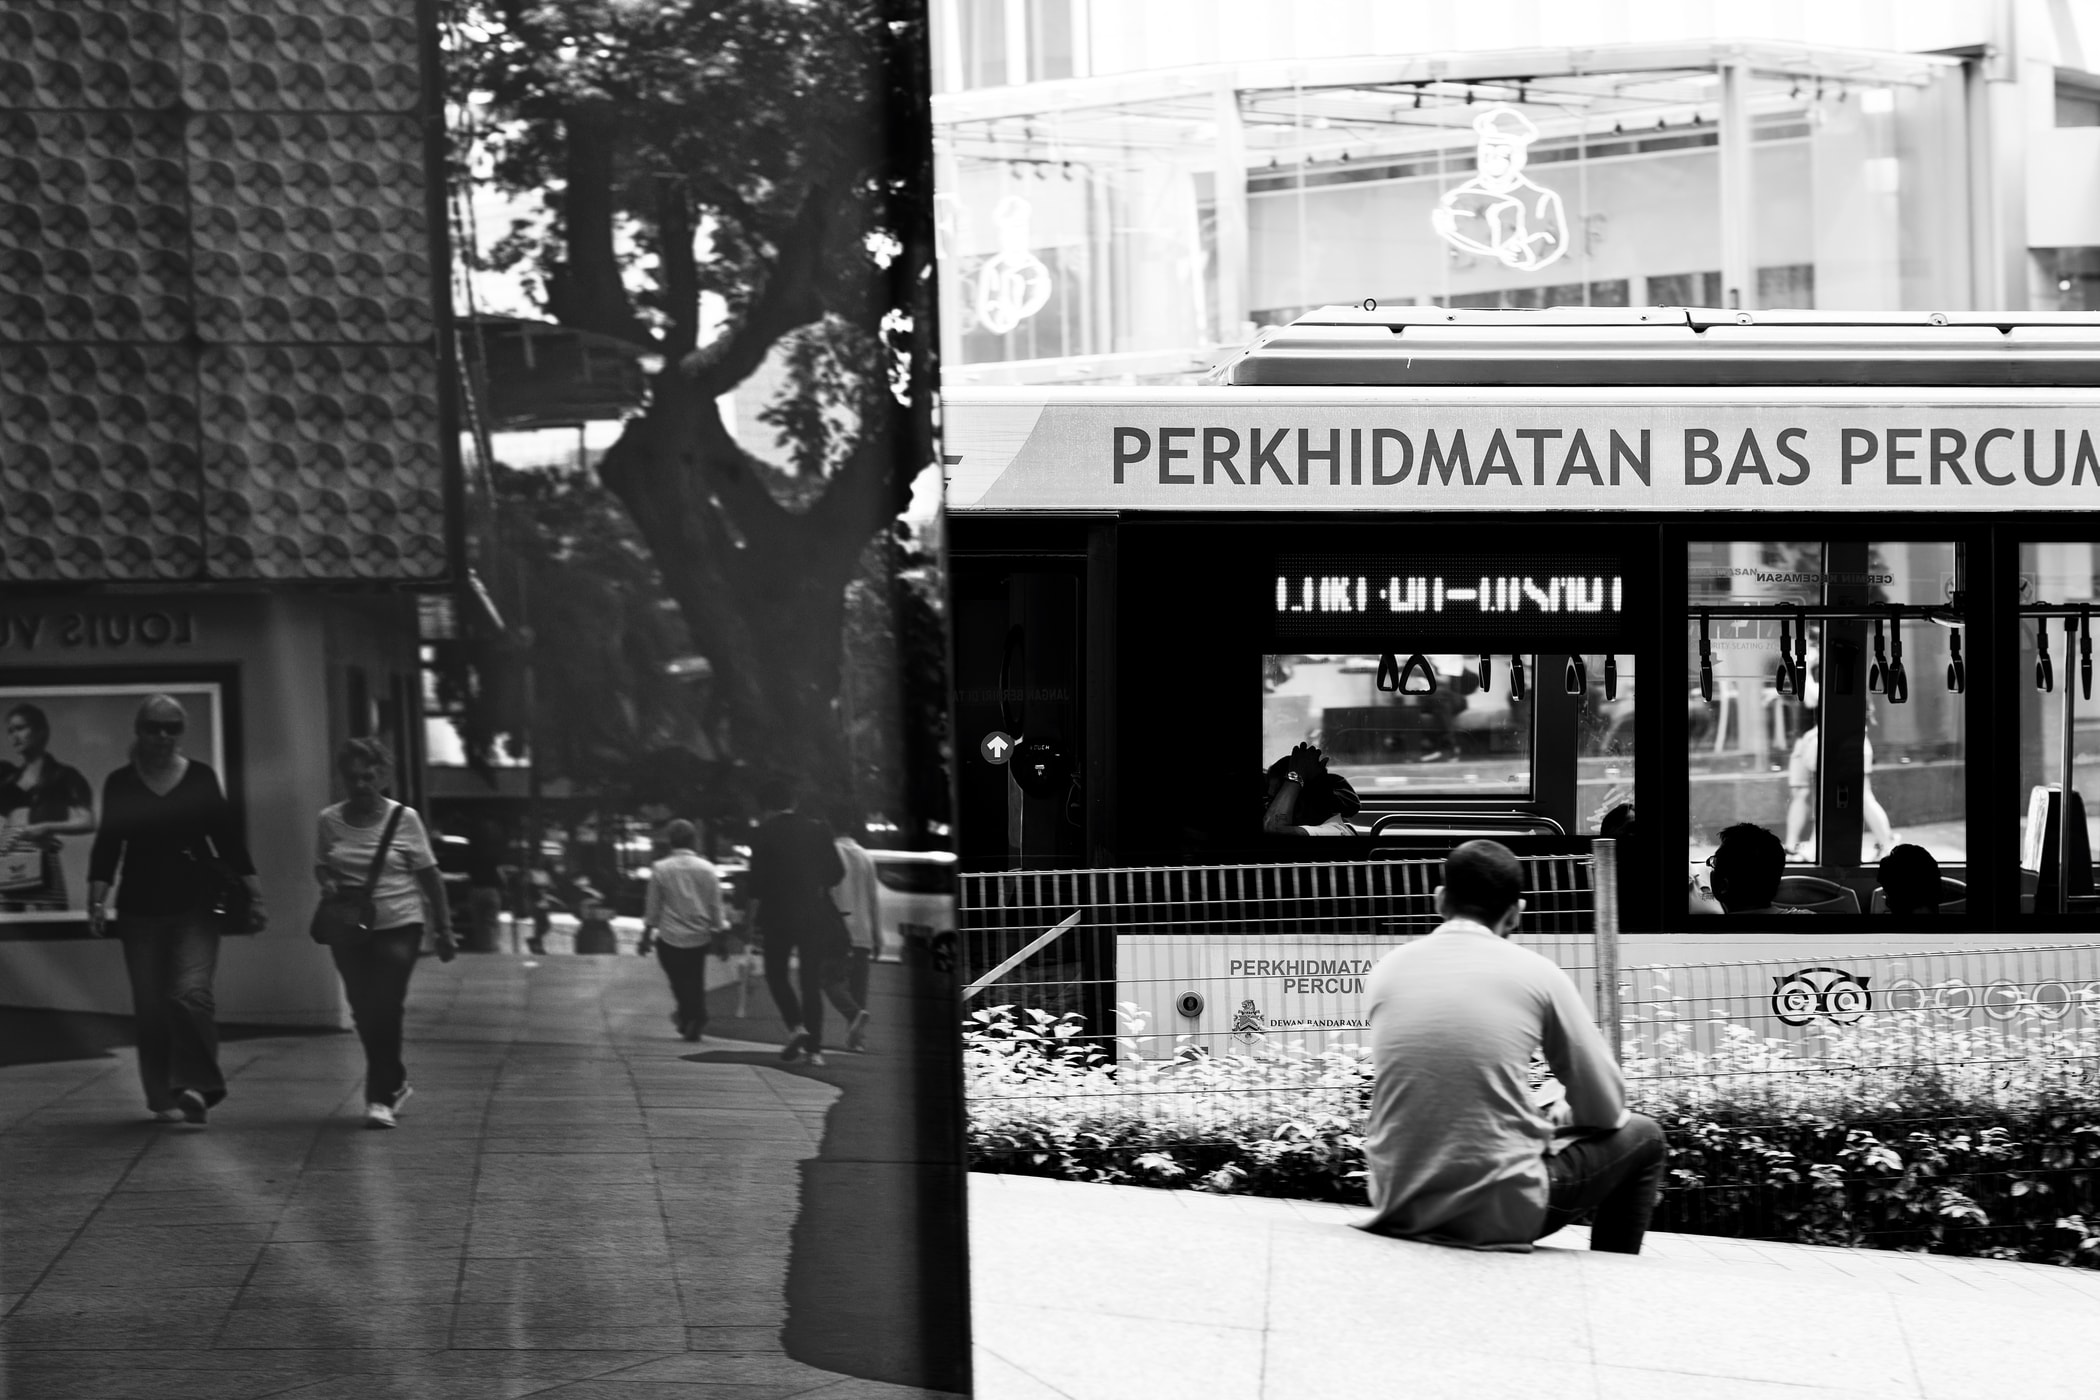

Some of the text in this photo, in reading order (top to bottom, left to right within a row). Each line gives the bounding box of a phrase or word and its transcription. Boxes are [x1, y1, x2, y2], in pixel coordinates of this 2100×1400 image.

[1114, 427, 1651, 487] PERKHIDMATAN
[1685, 427, 1811, 486] BAS
[1230, 960, 1378, 976] PERKHIDMATA
[1270, 1019, 1304, 1027] DEWAN
[1307, 1019, 1363, 1027] BANDARAYA
